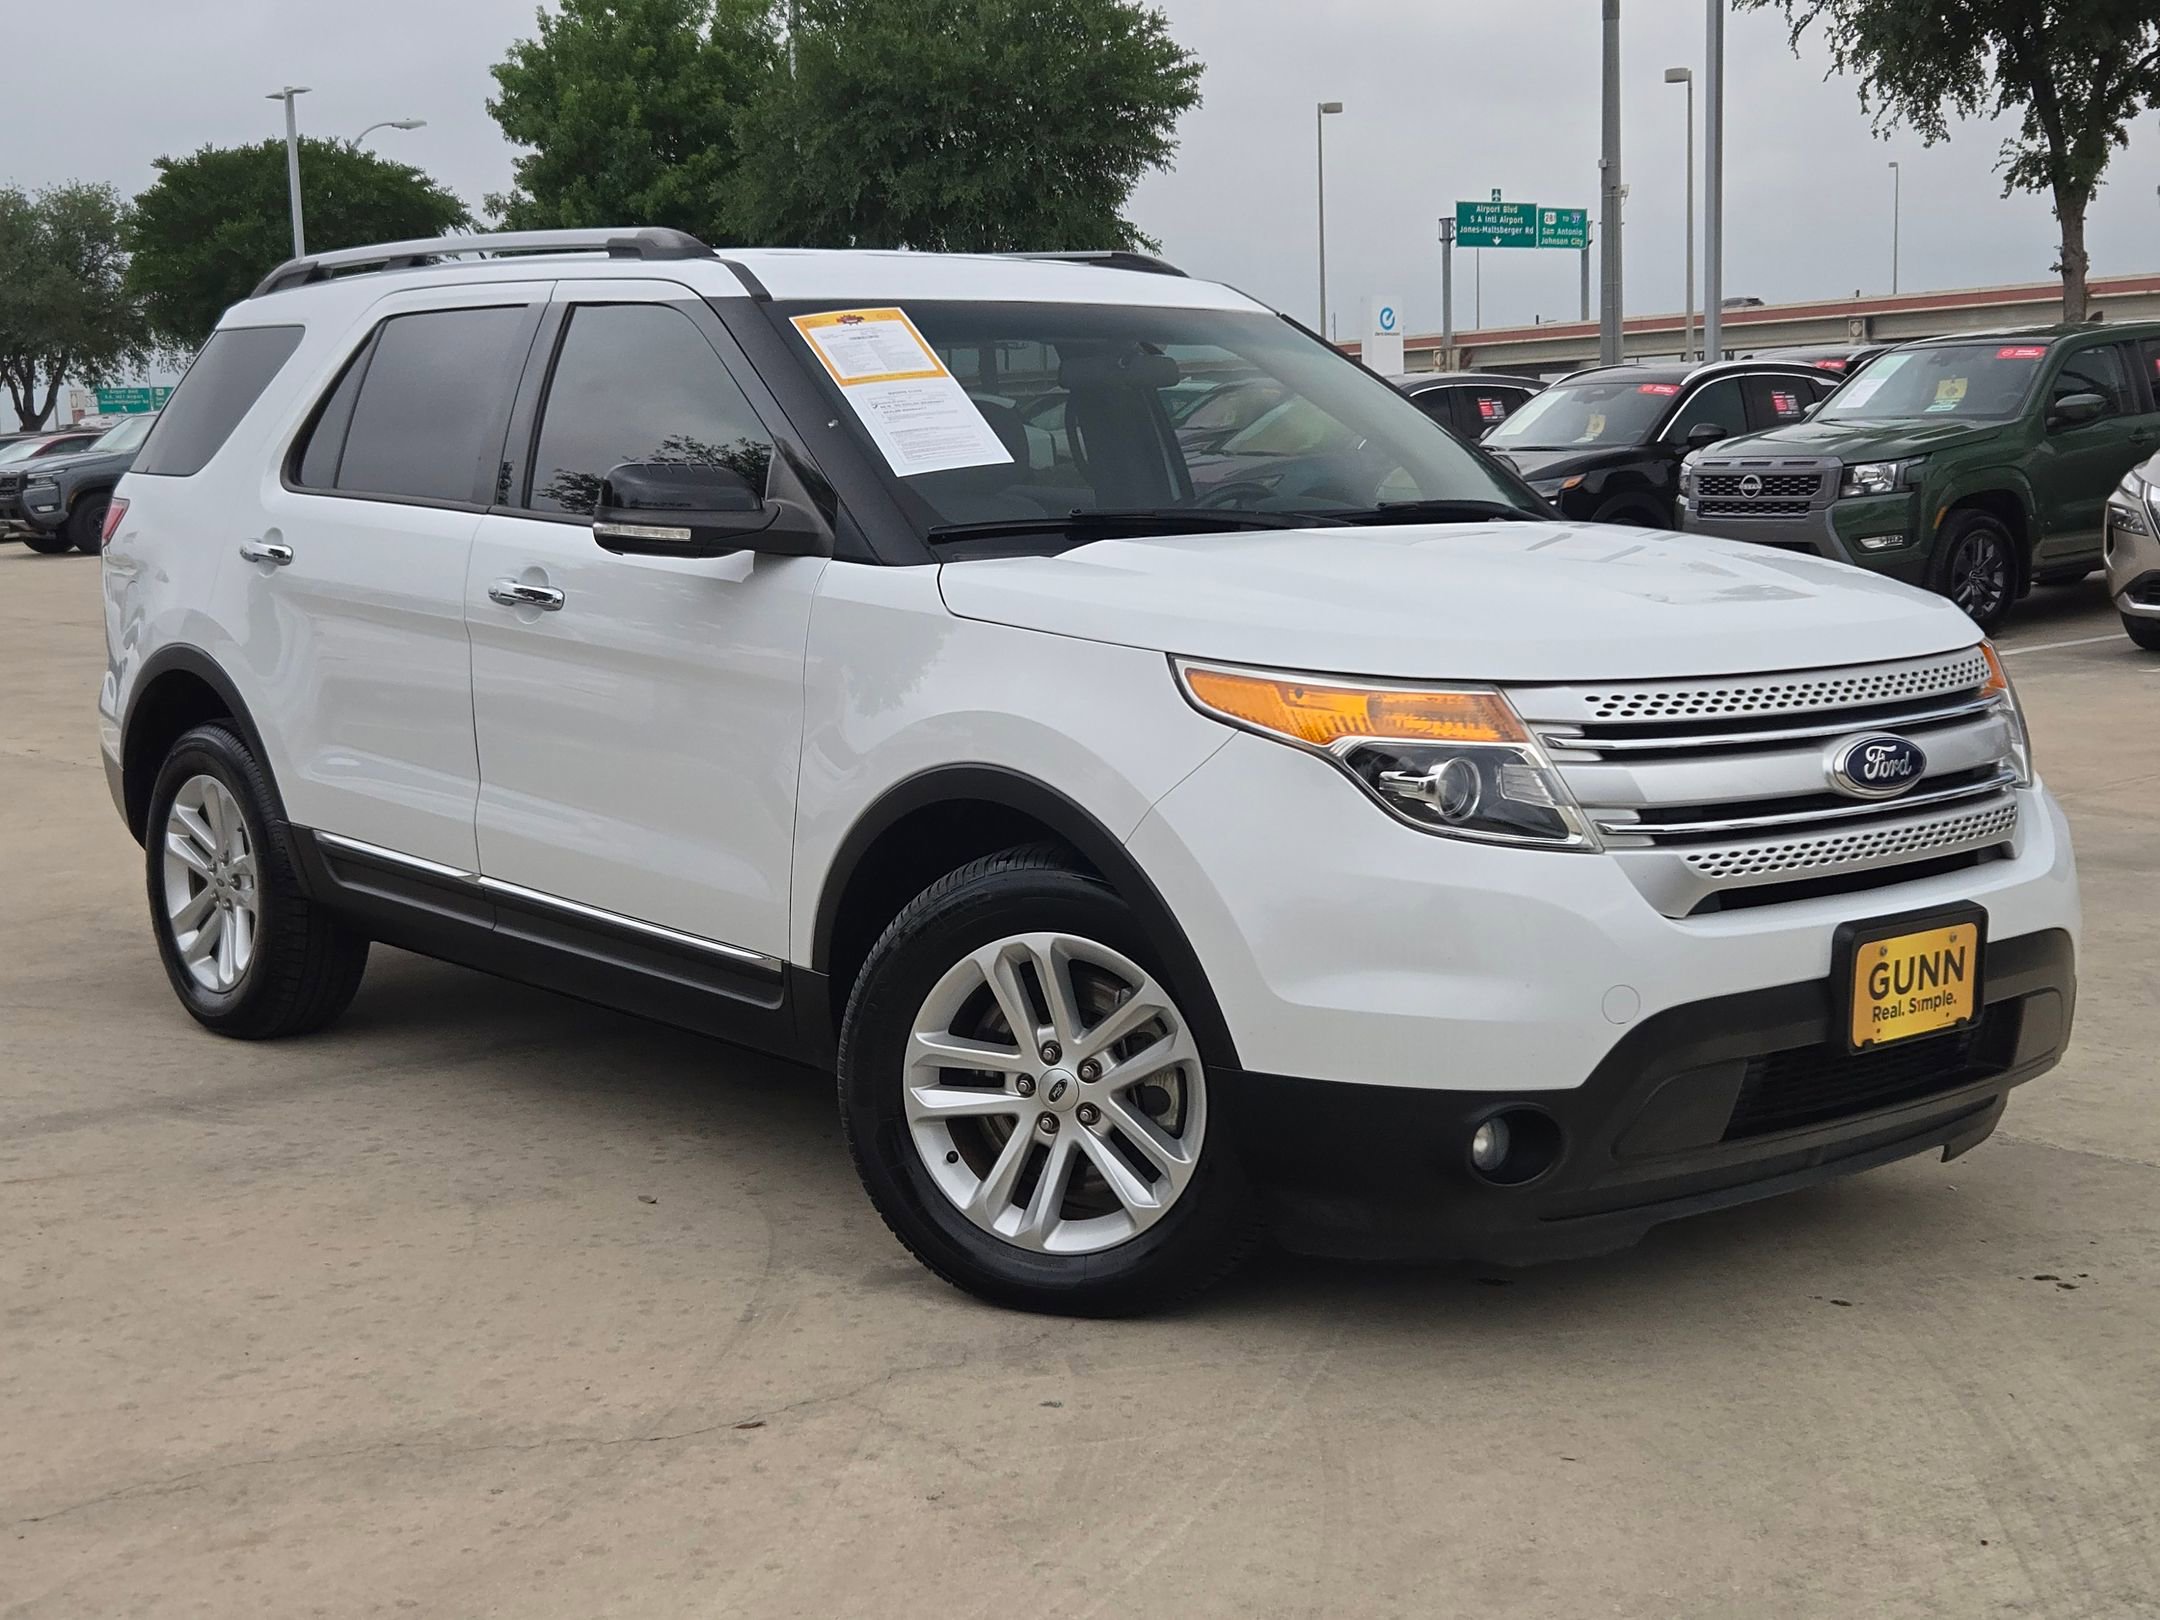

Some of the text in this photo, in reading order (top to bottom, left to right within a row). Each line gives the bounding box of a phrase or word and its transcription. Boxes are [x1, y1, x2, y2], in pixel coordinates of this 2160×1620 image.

[1476, 205, 1518, 214] Airport Blvd
[1470, 215, 1475, 223] S
[1477, 215, 1482, 223] A
[1499, 216, 1524, 225] Airport
[1525, 226, 1534, 234] Rd
[1542, 227, 1583, 236] San Antonio
[1541, 237, 1583, 247] Johnson City
[1864, 745, 1912, 780] Ford
[1868, 945, 1965, 1001] GUNN
[1872, 989, 1957, 1023] Real. Simple.
